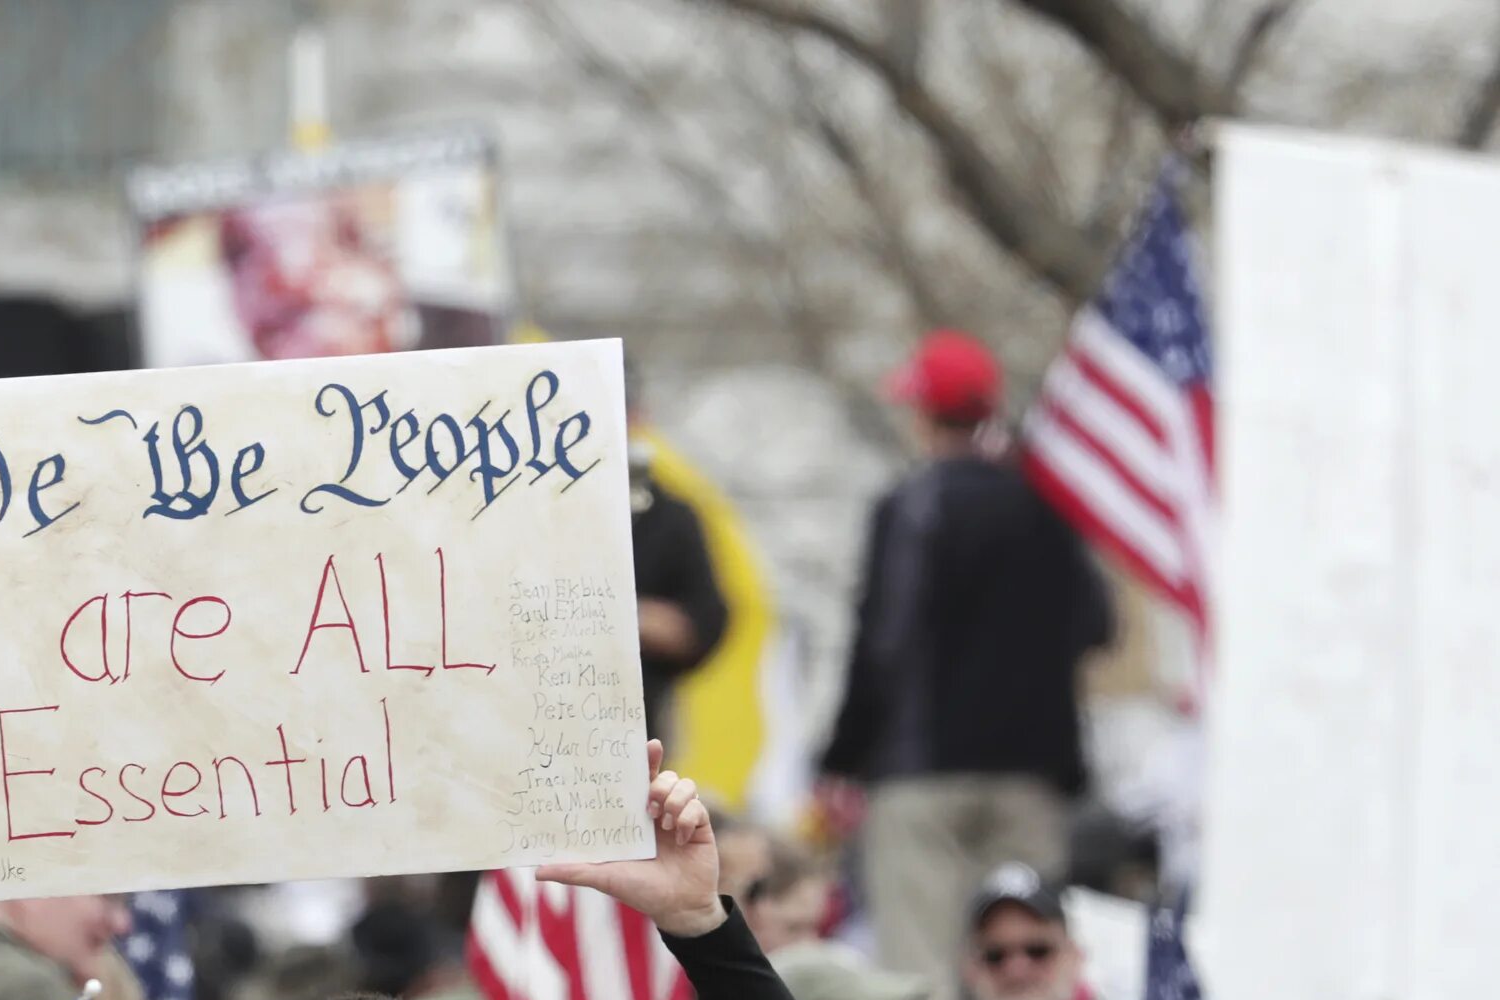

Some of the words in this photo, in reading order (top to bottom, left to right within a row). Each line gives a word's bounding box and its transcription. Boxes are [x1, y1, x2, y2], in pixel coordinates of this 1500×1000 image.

[77, 405, 278, 519] The
[300, 370, 601, 521] People
[60, 590, 232, 686] are
[289, 547, 497, 676] ALL
[509, 600, 549, 624] Paul
[532, 691, 576, 720] Pete
[581, 692, 642, 722] Charles
[507, 791, 563, 816] Jared
